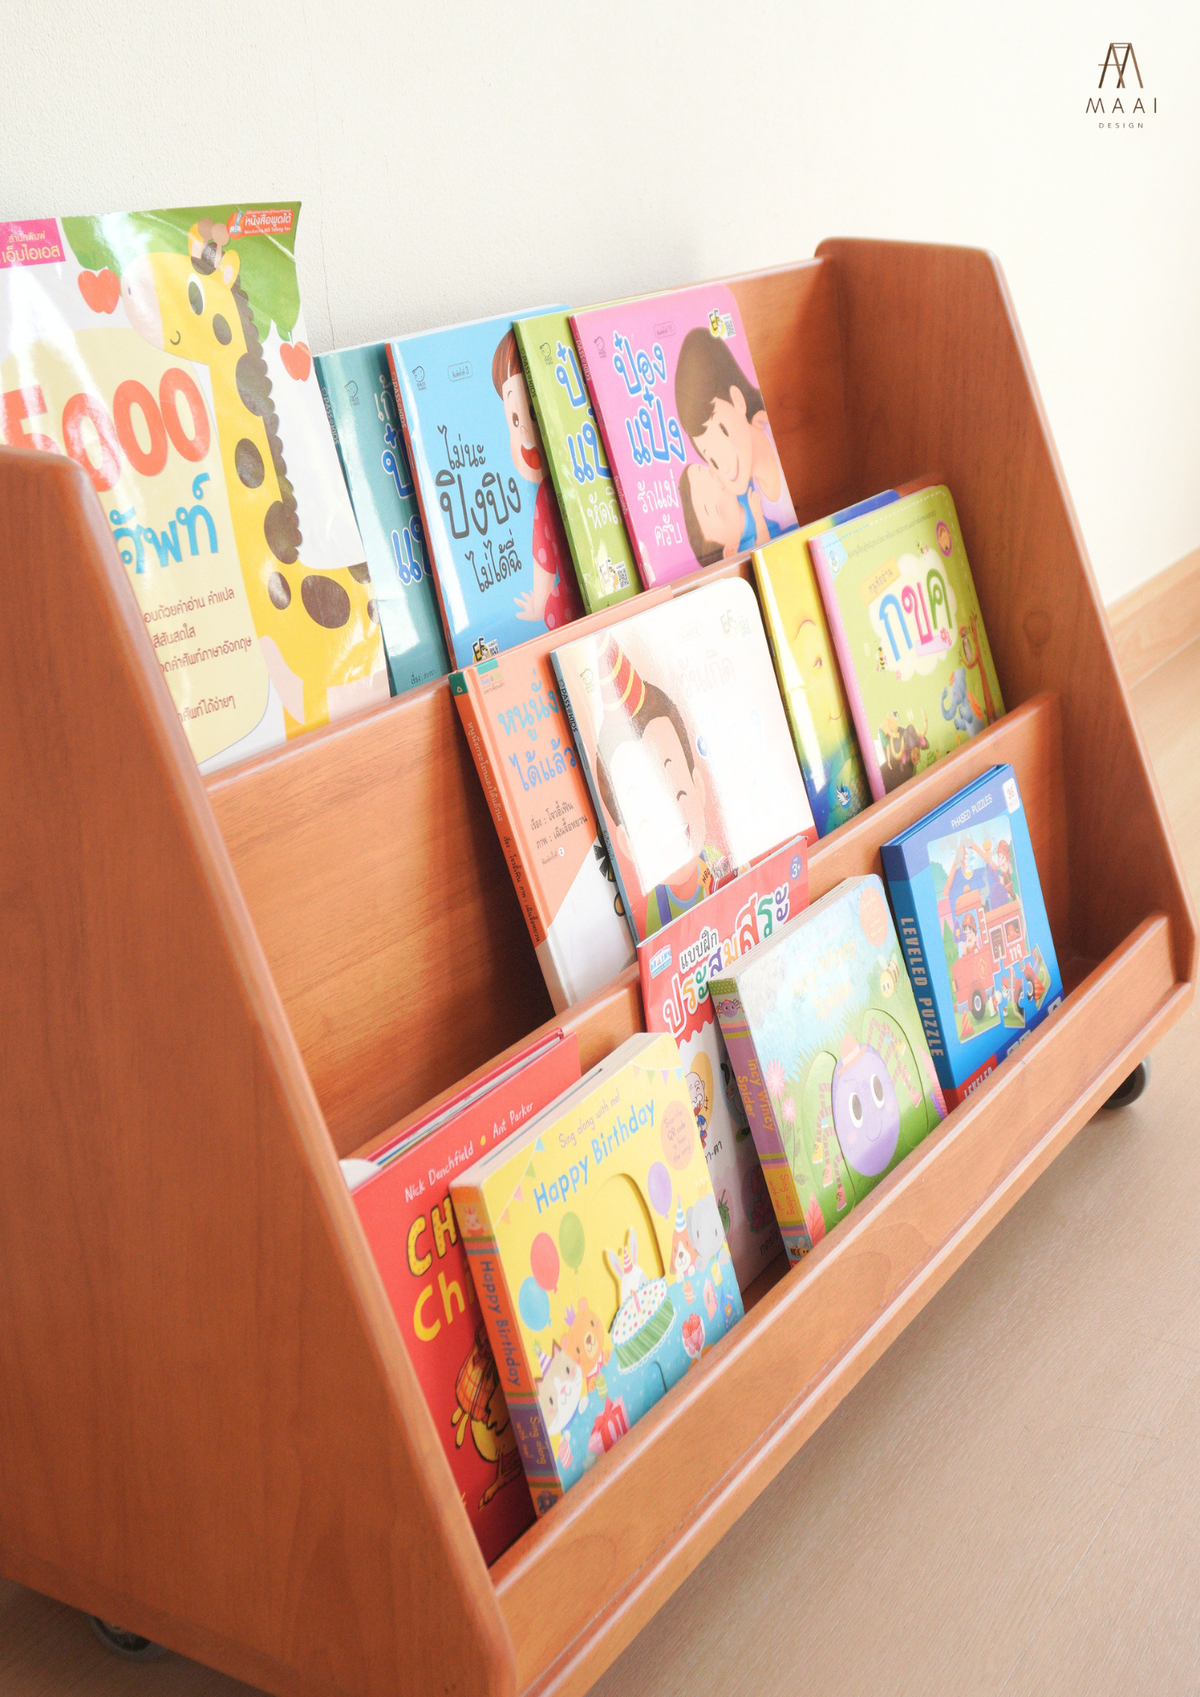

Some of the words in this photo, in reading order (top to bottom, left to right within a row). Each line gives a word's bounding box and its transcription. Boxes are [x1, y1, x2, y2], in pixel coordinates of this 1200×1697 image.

[8, 230, 46, 243] สำนักพิมพ์
[244, 212, 292, 228] หนังสือพูดได้
[612, 330, 667, 396] ป๋อง
[437, 424, 486, 470] ไม่นะ
[624, 385, 687, 467] แป๋ง
[435, 469, 522, 539] ปิงปิง
[637, 469, 680, 513] รักแม่
[654, 514, 683, 547] ครับ
[208, 587, 235, 606] คำแปล
[497, 668, 560, 741] หนูนั่ง
[508, 737, 576, 792] ได้แล้ว
[951, 810, 972, 830] PHASED
[971, 792, 994, 816] PUZZLES
[536, 837, 549, 850] ภาพ
[680, 926, 719, 970] แบบฝึก
[1009, 943, 1023, 962] 119
[900, 917, 928, 987] LEVELED
[918, 997, 944, 1058] PUZZLE
[737, 1075, 756, 1118] Spider
[747, 1058, 761, 1086] Incy
[758, 1089, 775, 1131] Wincy
[558, 1132, 577, 1149] Sing
[576, 1115, 596, 1135] along
[595, 1098, 610, 1119] with
[404, 1179, 425, 1203] Nick
[427, 1141, 474, 1188] Denchfield
[492, 1119, 507, 1139] Ant
[508, 1101, 535, 1129] Parker
[533, 1155, 589, 1215] Happy
[590, 1099, 656, 1165] Birthday
[780, 1173, 790, 1193] Sing
[785, 1195, 797, 1216] along
[480, 1260, 502, 1314] Happy
[496, 1317, 521, 1387] Birthday
[529, 1416, 541, 1438] Sing
[535, 1440, 548, 1466] along
